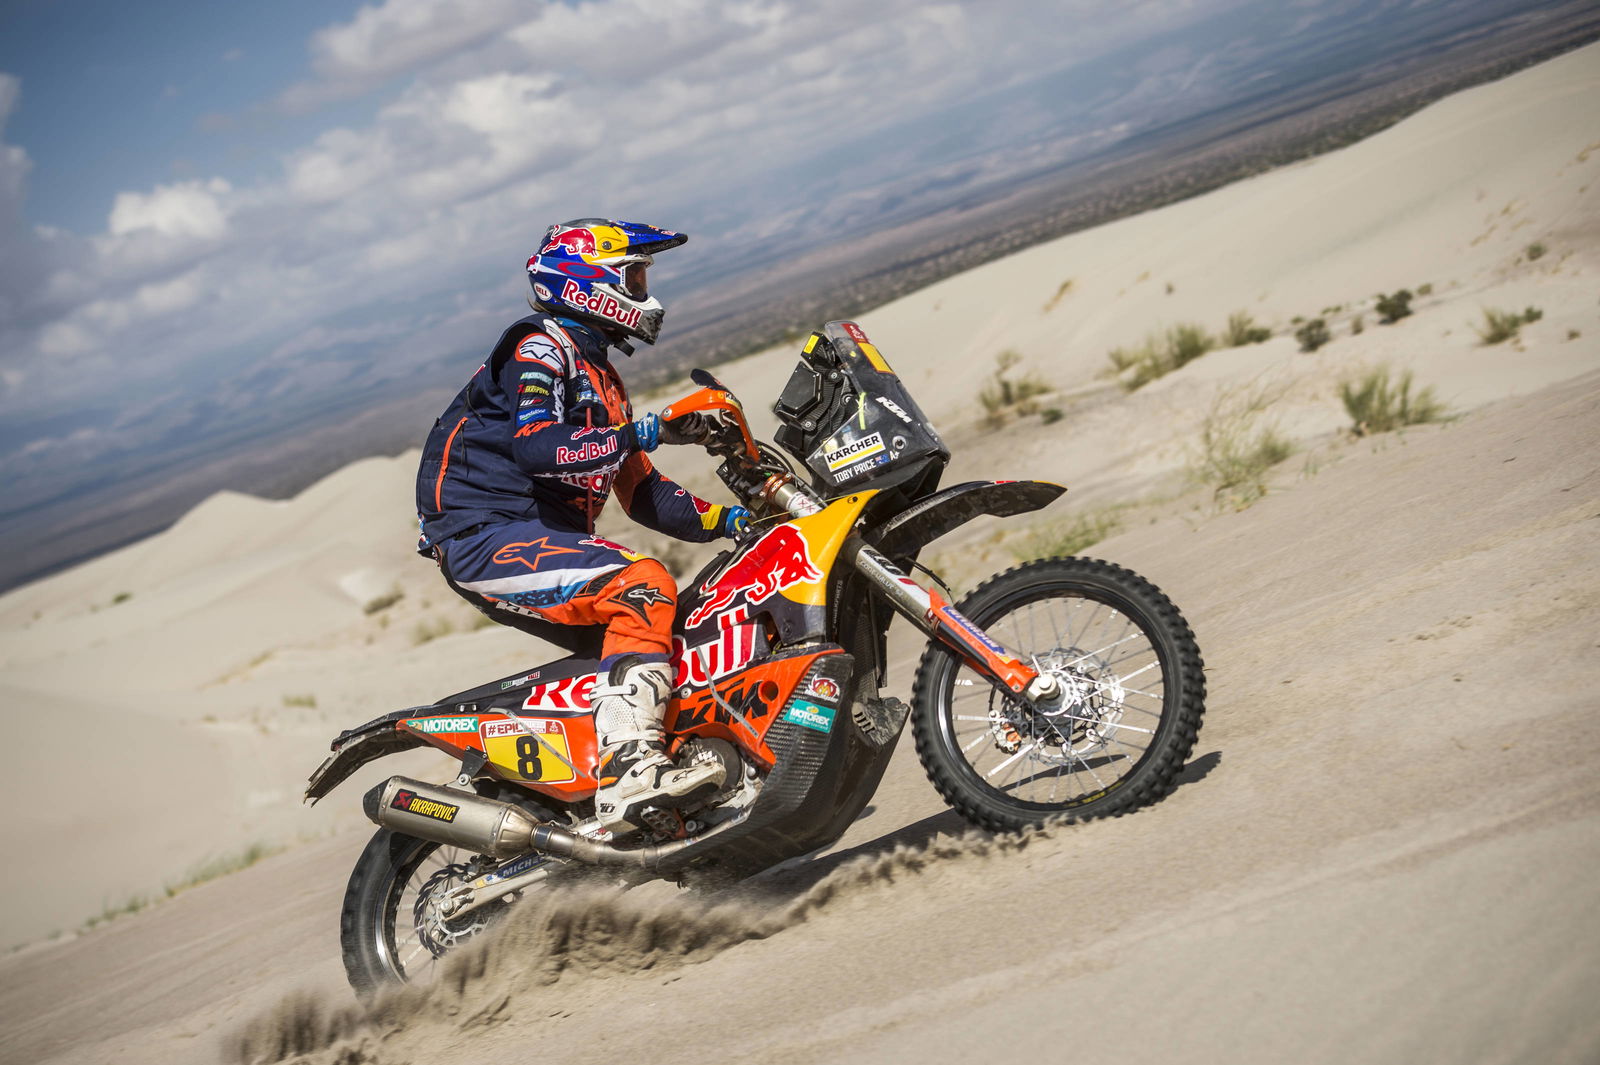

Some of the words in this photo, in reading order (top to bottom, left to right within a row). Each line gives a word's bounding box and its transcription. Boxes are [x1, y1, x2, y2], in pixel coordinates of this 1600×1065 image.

[535, 285, 548, 298] BELL
[561, 278, 605, 312] Red
[602, 301, 643, 330] Bull
[876, 396, 912, 423] KTM
[557, 442, 588, 464] Red
[589, 435, 617, 460] Bull
[826, 435, 880, 463] KÄRCHER
[833, 465, 854, 483] TOBY
[853, 459, 877, 475] PRICE
[521, 672, 597, 713] Re
[423, 718, 476, 733] MOTOREX
[790, 707, 830, 726] MOTOREX
[516, 736, 543, 781] 8
